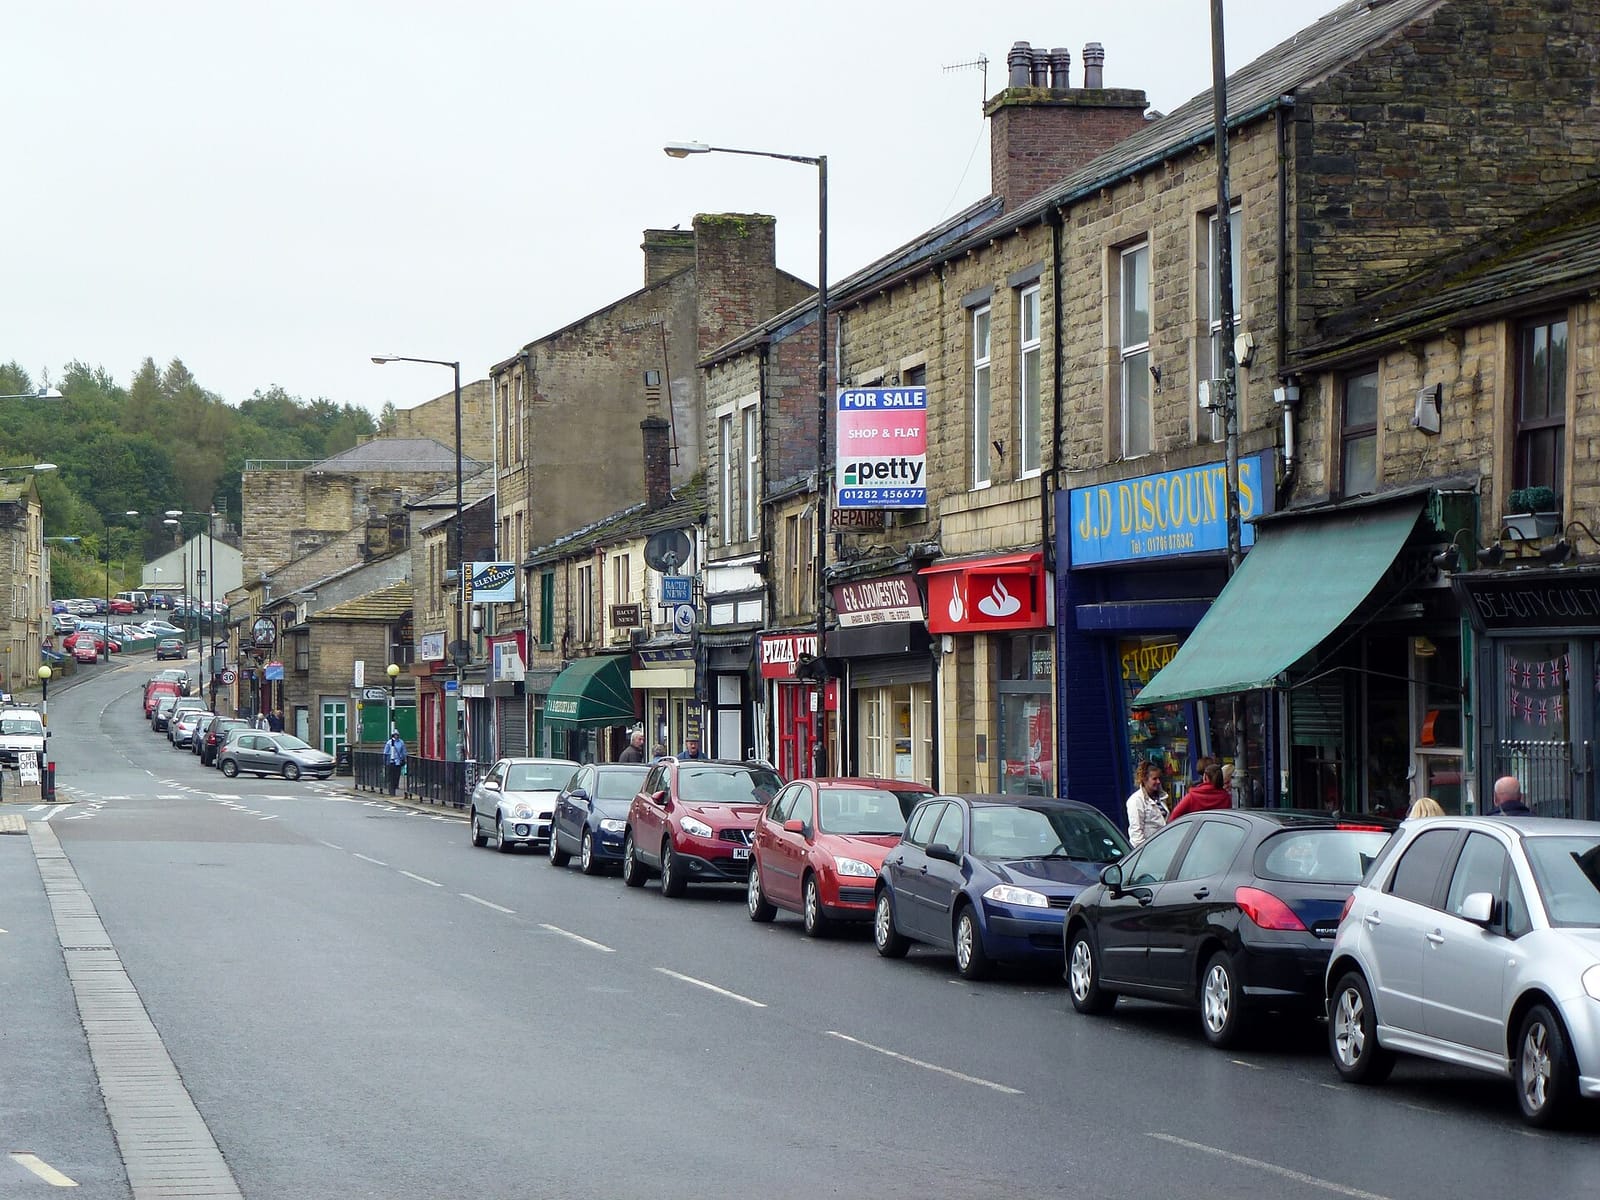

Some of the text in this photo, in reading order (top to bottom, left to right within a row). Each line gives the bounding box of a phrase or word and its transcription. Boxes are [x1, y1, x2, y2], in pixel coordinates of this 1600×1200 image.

[844, 391, 923, 407] FOR SALE
[847, 427, 920, 439] SHOP & FLAT
[858, 457, 924, 485] petty
[844, 489, 924, 499] 01282 456677
[1079, 462, 1254, 542] J.D DISCOUNTS
[831, 509, 883, 527] REPAIRS
[464, 564, 473, 601] FOR SALE
[473, 567, 515, 588] ELEYLONG
[665, 581, 688, 590] BACUP
[666, 590, 687, 598] NEWS
[842, 587, 853, 611] G
[849, 586, 860, 610] &
[862, 579, 909, 609] DOMESTICS
[1473, 587, 1600, 618] BEAUTY CULT
[762, 636, 818, 663] PIZZA KIN
[223, 673, 234, 681] 30
[20, 753, 36, 762] CAFE
[20, 761, 37, 770] OPEN
